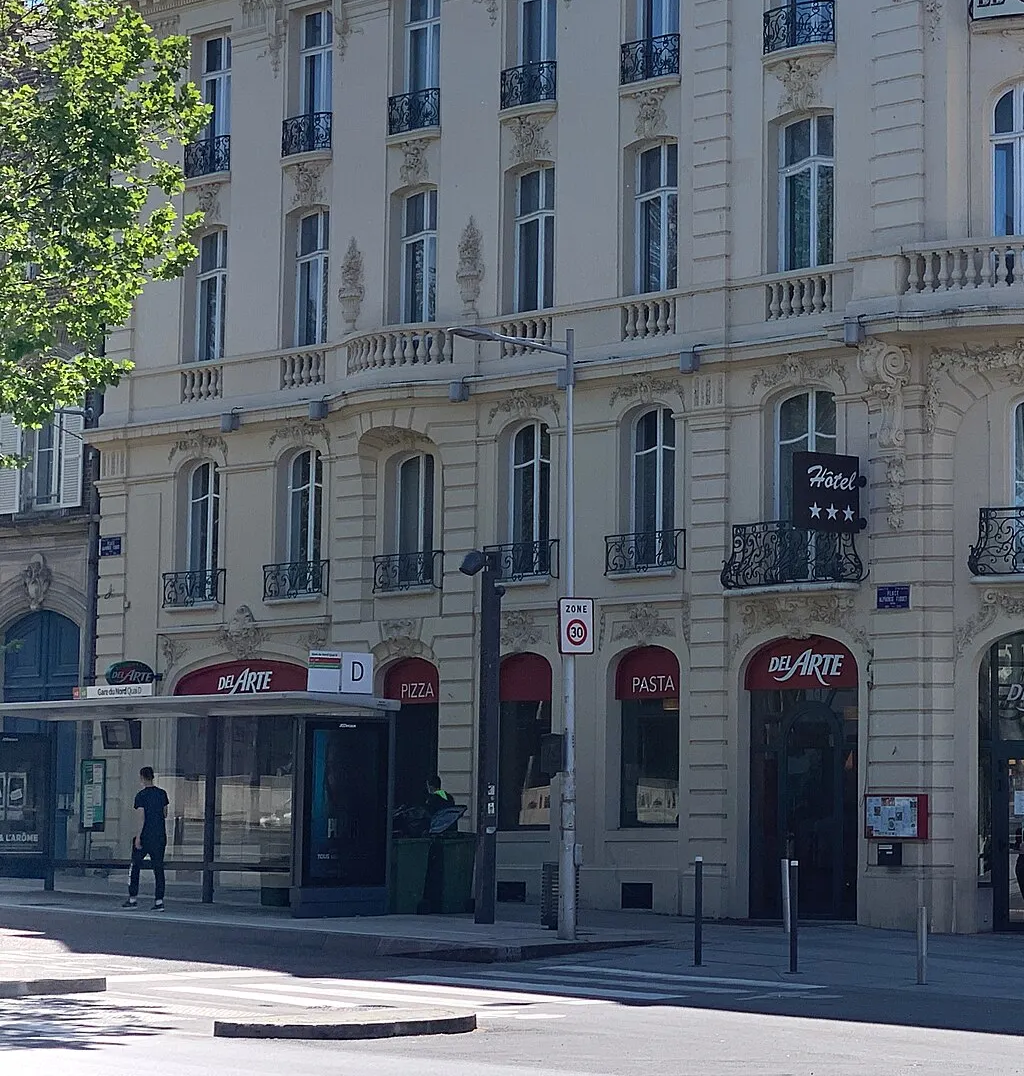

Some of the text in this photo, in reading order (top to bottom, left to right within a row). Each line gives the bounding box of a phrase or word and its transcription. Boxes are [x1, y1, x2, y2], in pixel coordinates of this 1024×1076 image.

[807, 465, 857, 490] Hôtel
[565, 605, 587, 613] ZONE
[570, 627, 583, 638] 30
[351, 661, 364, 681] D
[773, 648, 844, 686] ARTE
[229, 668, 273, 694] ARTE
[401, 682, 434, 698] PIZZA
[632, 675, 675, 693] PASTA
[6, 832, 39, 842] L'ARÔME
